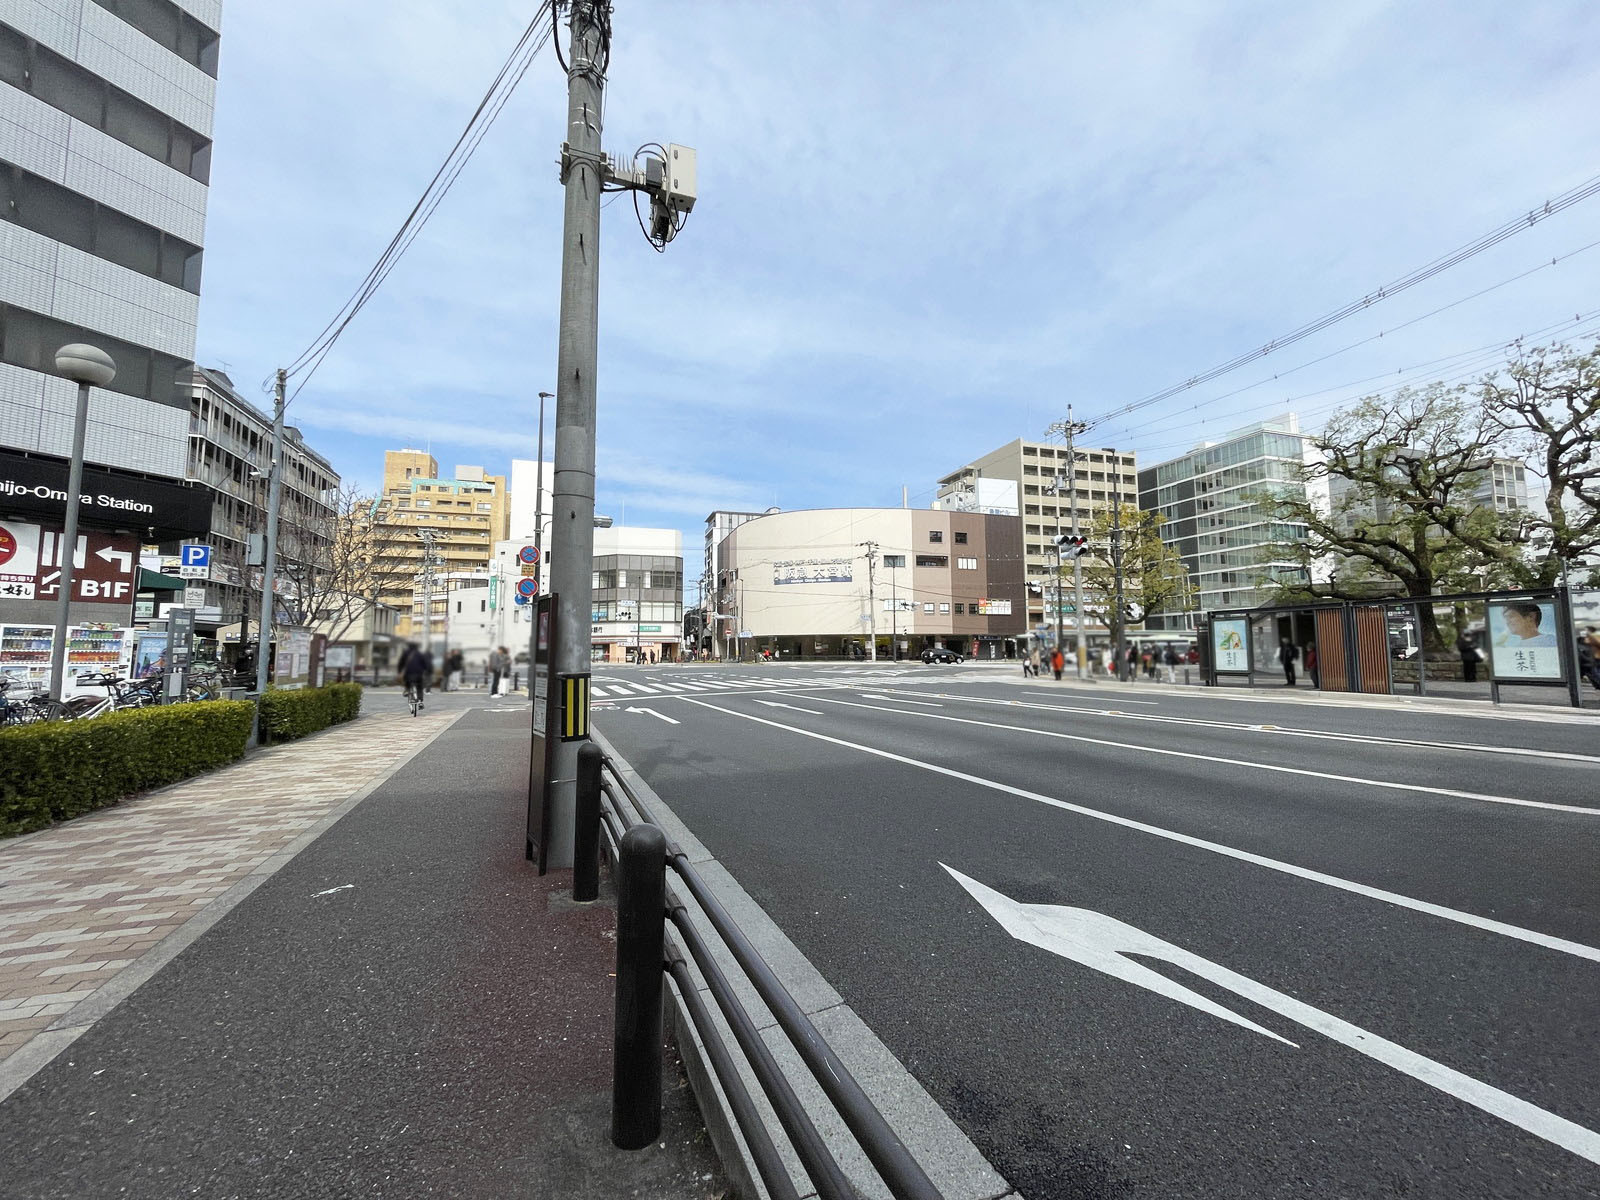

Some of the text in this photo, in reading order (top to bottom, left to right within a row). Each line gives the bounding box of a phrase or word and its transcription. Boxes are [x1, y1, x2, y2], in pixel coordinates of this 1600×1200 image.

[97, 495, 153, 513] Station
[188, 547, 205, 565] P
[80, 579, 130, 598] B1F
[1514, 650, 1529, 672] 生茶
